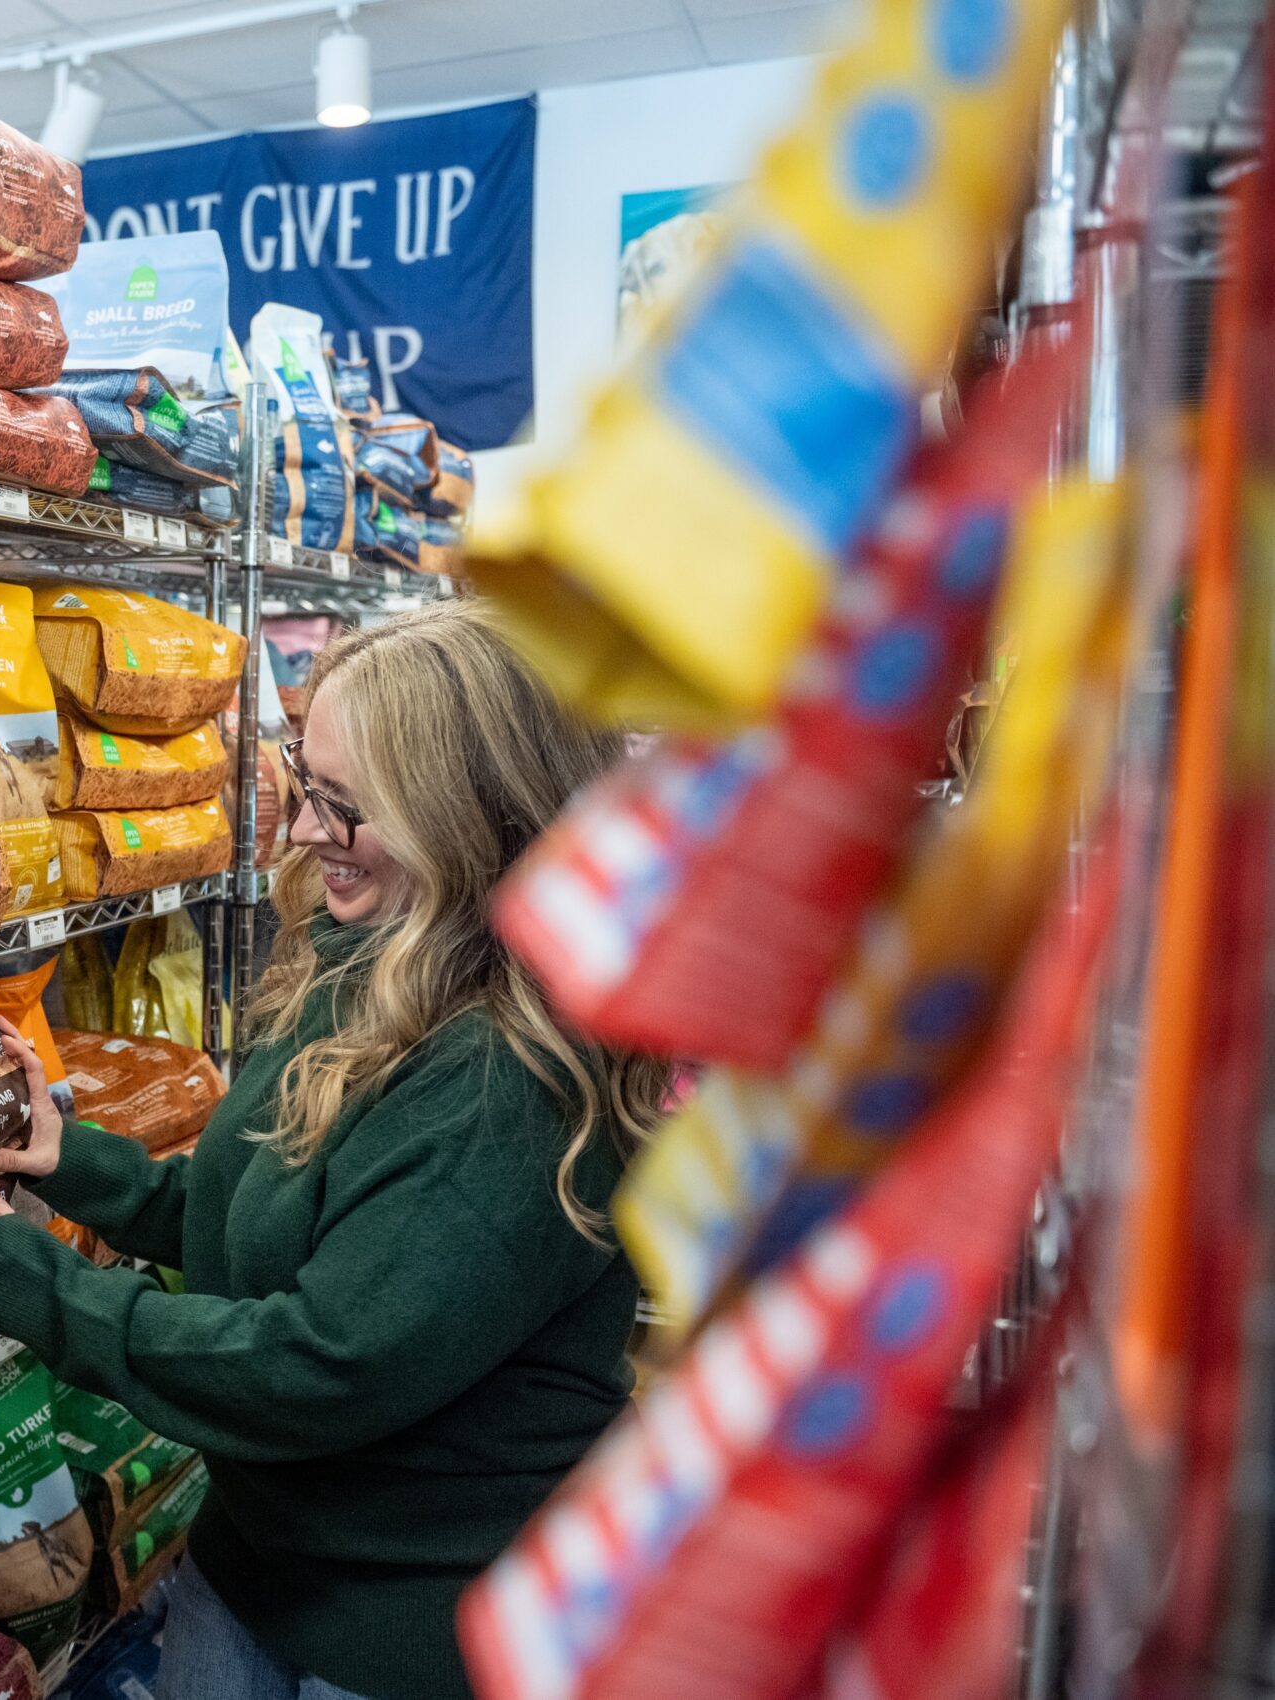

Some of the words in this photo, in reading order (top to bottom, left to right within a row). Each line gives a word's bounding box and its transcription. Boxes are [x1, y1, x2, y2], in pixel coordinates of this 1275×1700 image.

[240, 178, 377, 272] GIVE
[395, 165, 475, 264] UP
[130, 281, 154, 290] OPEN
[84, 305, 137, 326] SMALL
[142, 298, 196, 321] BREED
[151, 412, 182, 429] FARM
[92, 468, 107, 476] PEN
